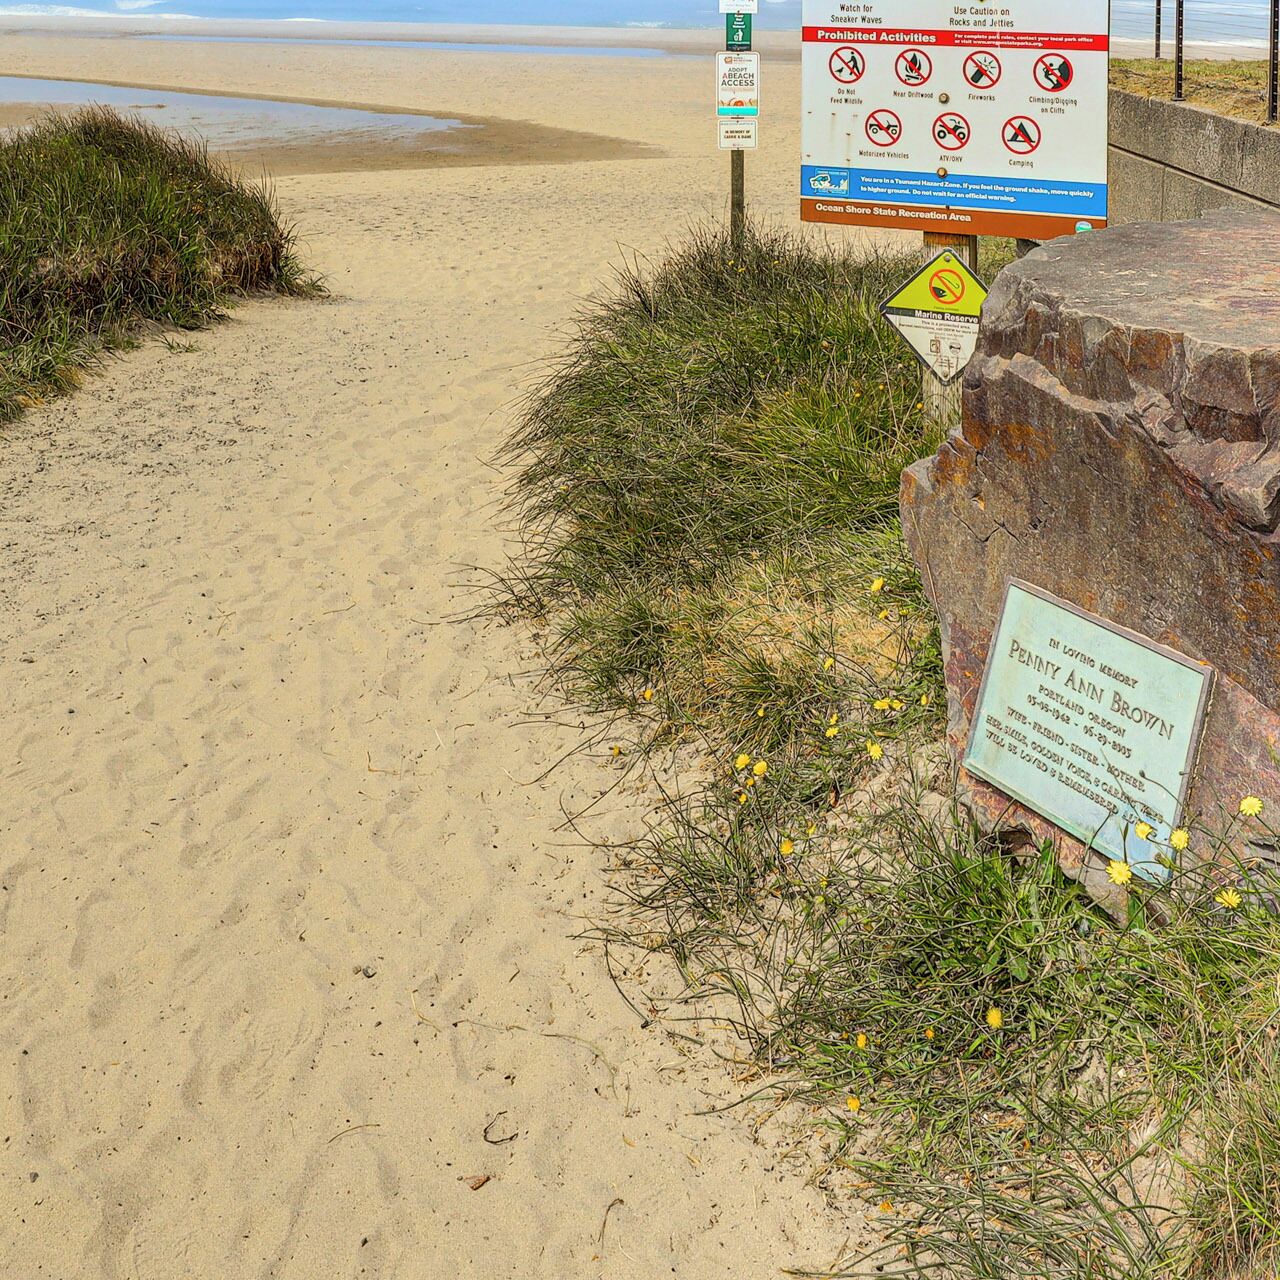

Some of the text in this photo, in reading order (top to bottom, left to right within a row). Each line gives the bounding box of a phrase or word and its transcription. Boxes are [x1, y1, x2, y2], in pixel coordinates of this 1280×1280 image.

[840, 4, 861, 12] Watch
[954, 6, 967, 14] Use
[970, 6, 998, 15] Caution
[830, 15, 882, 24] Sneaker Waves
[950, 18, 1014, 27] Rocks and Jetties
[817, 30, 936, 42] Prohibited Activities
[845, 97, 863, 105] Wildlife
[1029, 96, 1077, 106] Climbing/Digging
[858, 150, 909, 159] Motorized Vehicles
[1008, 159, 1034, 168] Camping
[1069, 190, 1093, 198] quickly
[815, 203, 971, 222] Ocean Shore State Recreation Area
[915, 310, 979, 323] Marine Reserve
[1049, 638, 1138, 688] IN LOVING MEMORY
[1008, 639, 1174, 740] PENNY ANN BROWN
[1038, 684, 1126, 738] PORTLAND OREGON
[1008, 706, 1027, 725] WIFE
[1033, 721, 1064, 745] FRIEND
[1070, 743, 1099, 766] SISTER
[986, 714, 1002, 730] HER
[1004, 725, 1028, 747] SMILE,
[1031, 741, 1064, 766] GOLDEN
[1066, 760, 1092, 784] VOICE,
[986, 729, 1005, 747] WILL
[1008, 742, 1017, 754] BE
[1020, 750, 1048, 772] LOVED
[1058, 772, 1118, 814] REMEMBERED
